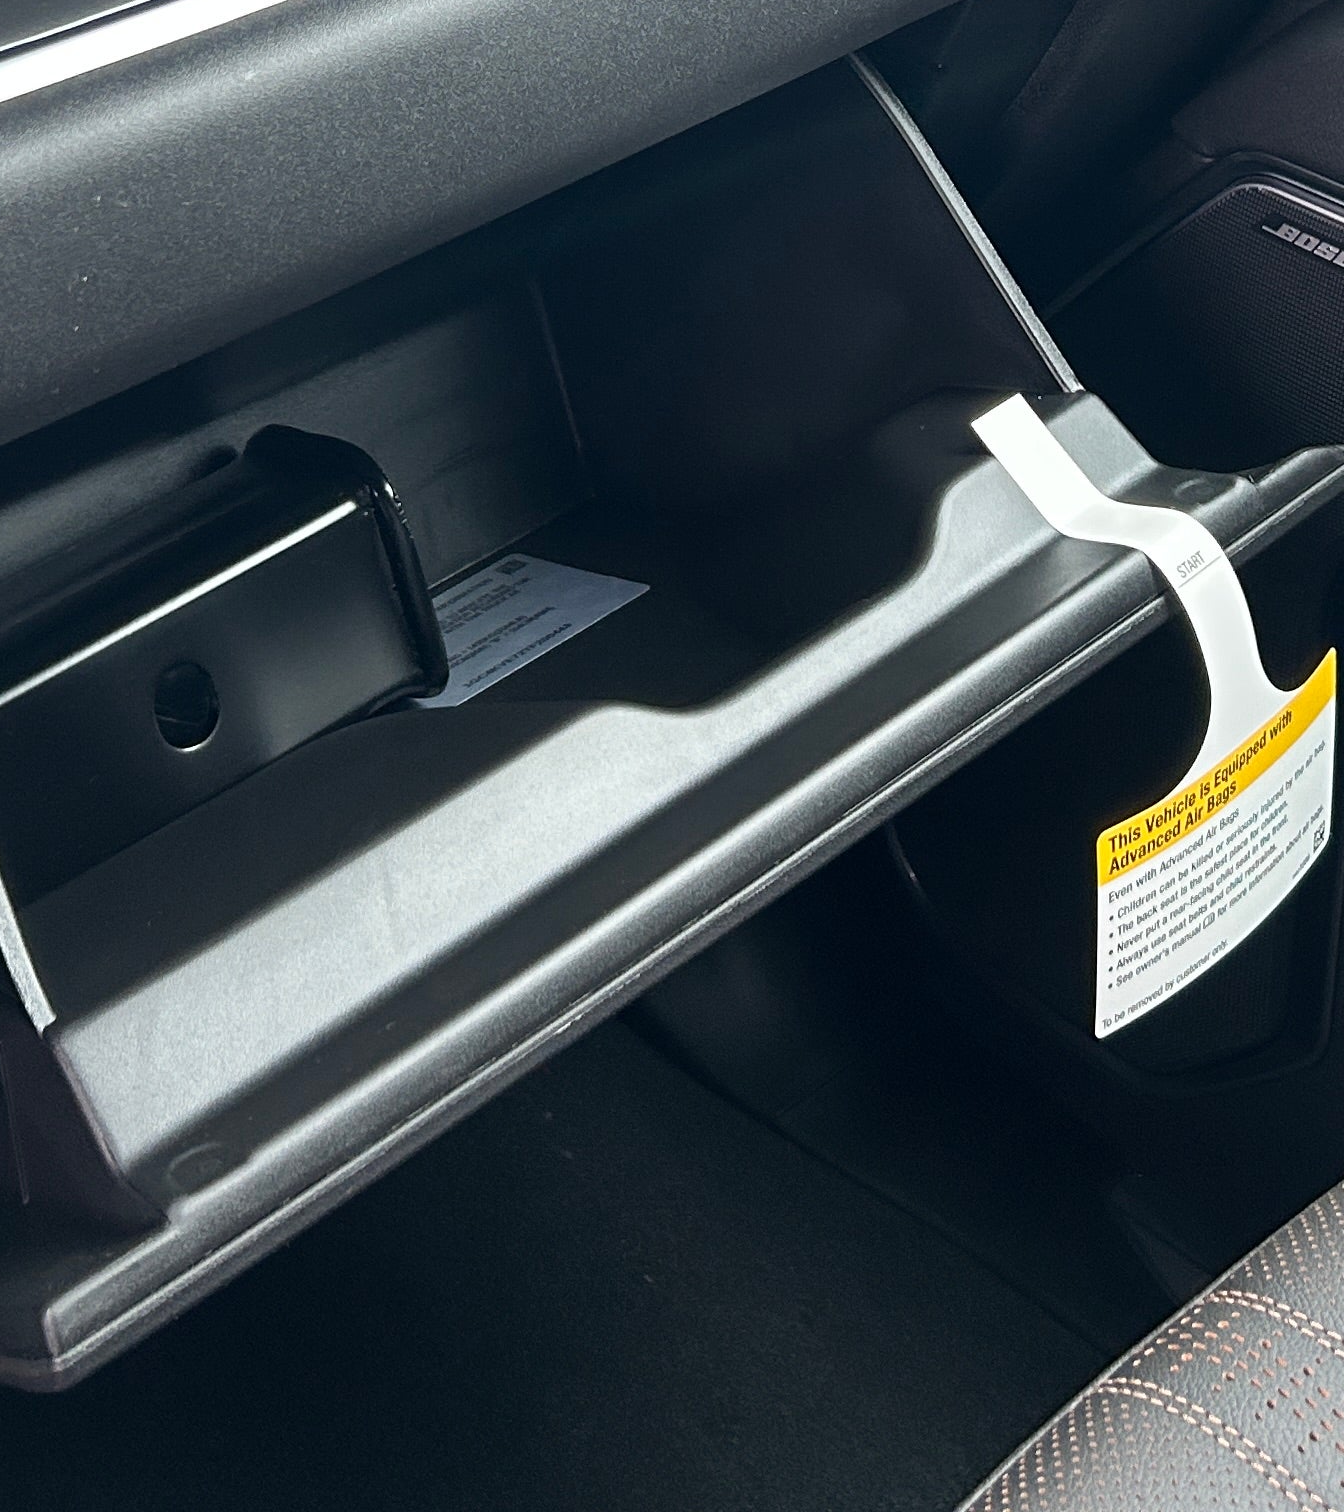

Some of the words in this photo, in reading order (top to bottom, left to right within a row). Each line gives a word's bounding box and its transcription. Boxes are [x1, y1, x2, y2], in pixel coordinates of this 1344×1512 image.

[1176, 550, 1205, 578] START
[1108, 826, 1141, 853] This
[1145, 792, 1196, 833] Vehicle
[1199, 781, 1210, 799] is
[1214, 730, 1267, 788] Equipped
[1269, 710, 1292, 740] with
[1109, 819, 1181, 875] Advanced
[1184, 806, 1203, 830] Air
[1207, 780, 1237, 813] Bags
[1108, 882, 1133, 904] Even
[1136, 868, 1157, 887] with
[1159, 835, 1203, 874] Advanced
[1206, 825, 1217, 841] Air
[1117, 890, 1156, 918] Children
[1159, 877, 1175, 894] can
[1178, 868, 1189, 881] be
[1191, 848, 1213, 872] killed
[1216, 841, 1224, 853] or
[1226, 811, 1259, 845] seriously
[1261, 784, 1283, 815] injured
[1285, 777, 1293, 790] by
[1295, 764, 1304, 780] the
[1117, 920, 1133, 936] The
[1137, 905, 1157, 925] back
[1160, 890, 1178, 910] seat
[1181, 886, 1187, 896] is
[1189, 875, 1203, 889] the
[1205, 853, 1227, 879] safest
[1229, 837, 1248, 861] place
[1250, 826, 1259, 841] for
[1117, 931, 1143, 953] Never
[1145, 919, 1160, 938] put
[1162, 916, 1168, 925] a
[1169, 882, 1214, 920] rear-facing
[1216, 864, 1233, 886] child
[1236, 850, 1251, 870] seat
[1252, 843, 1258, 855] in
[1260, 832, 1270, 847] the
[1116, 971, 1133, 987] See
[1135, 947, 1169, 975] owner's
[1172, 922, 1201, 952] manual
[1218, 903, 1227, 918] for
[1229, 887, 1247, 908] more
[1249, 850, 1284, 891] information
[1285, 829, 1301, 854] about
[1116, 944, 1148, 969] Always
[1151, 933, 1166, 949] use
[1169, 918, 1186, 937] seat
[1189, 904, 1208, 923] belts
[1210, 889, 1224, 908] and
[1226, 872, 1243, 895] child
[1102, 1017, 1112, 1029] To
[1114, 1010, 1125, 1023] be
[1127, 985, 1163, 1015] removed
[1165, 978, 1175, 991] by
[1176, 952, 1211, 984] customer
[1212, 939, 1229, 957] only.
